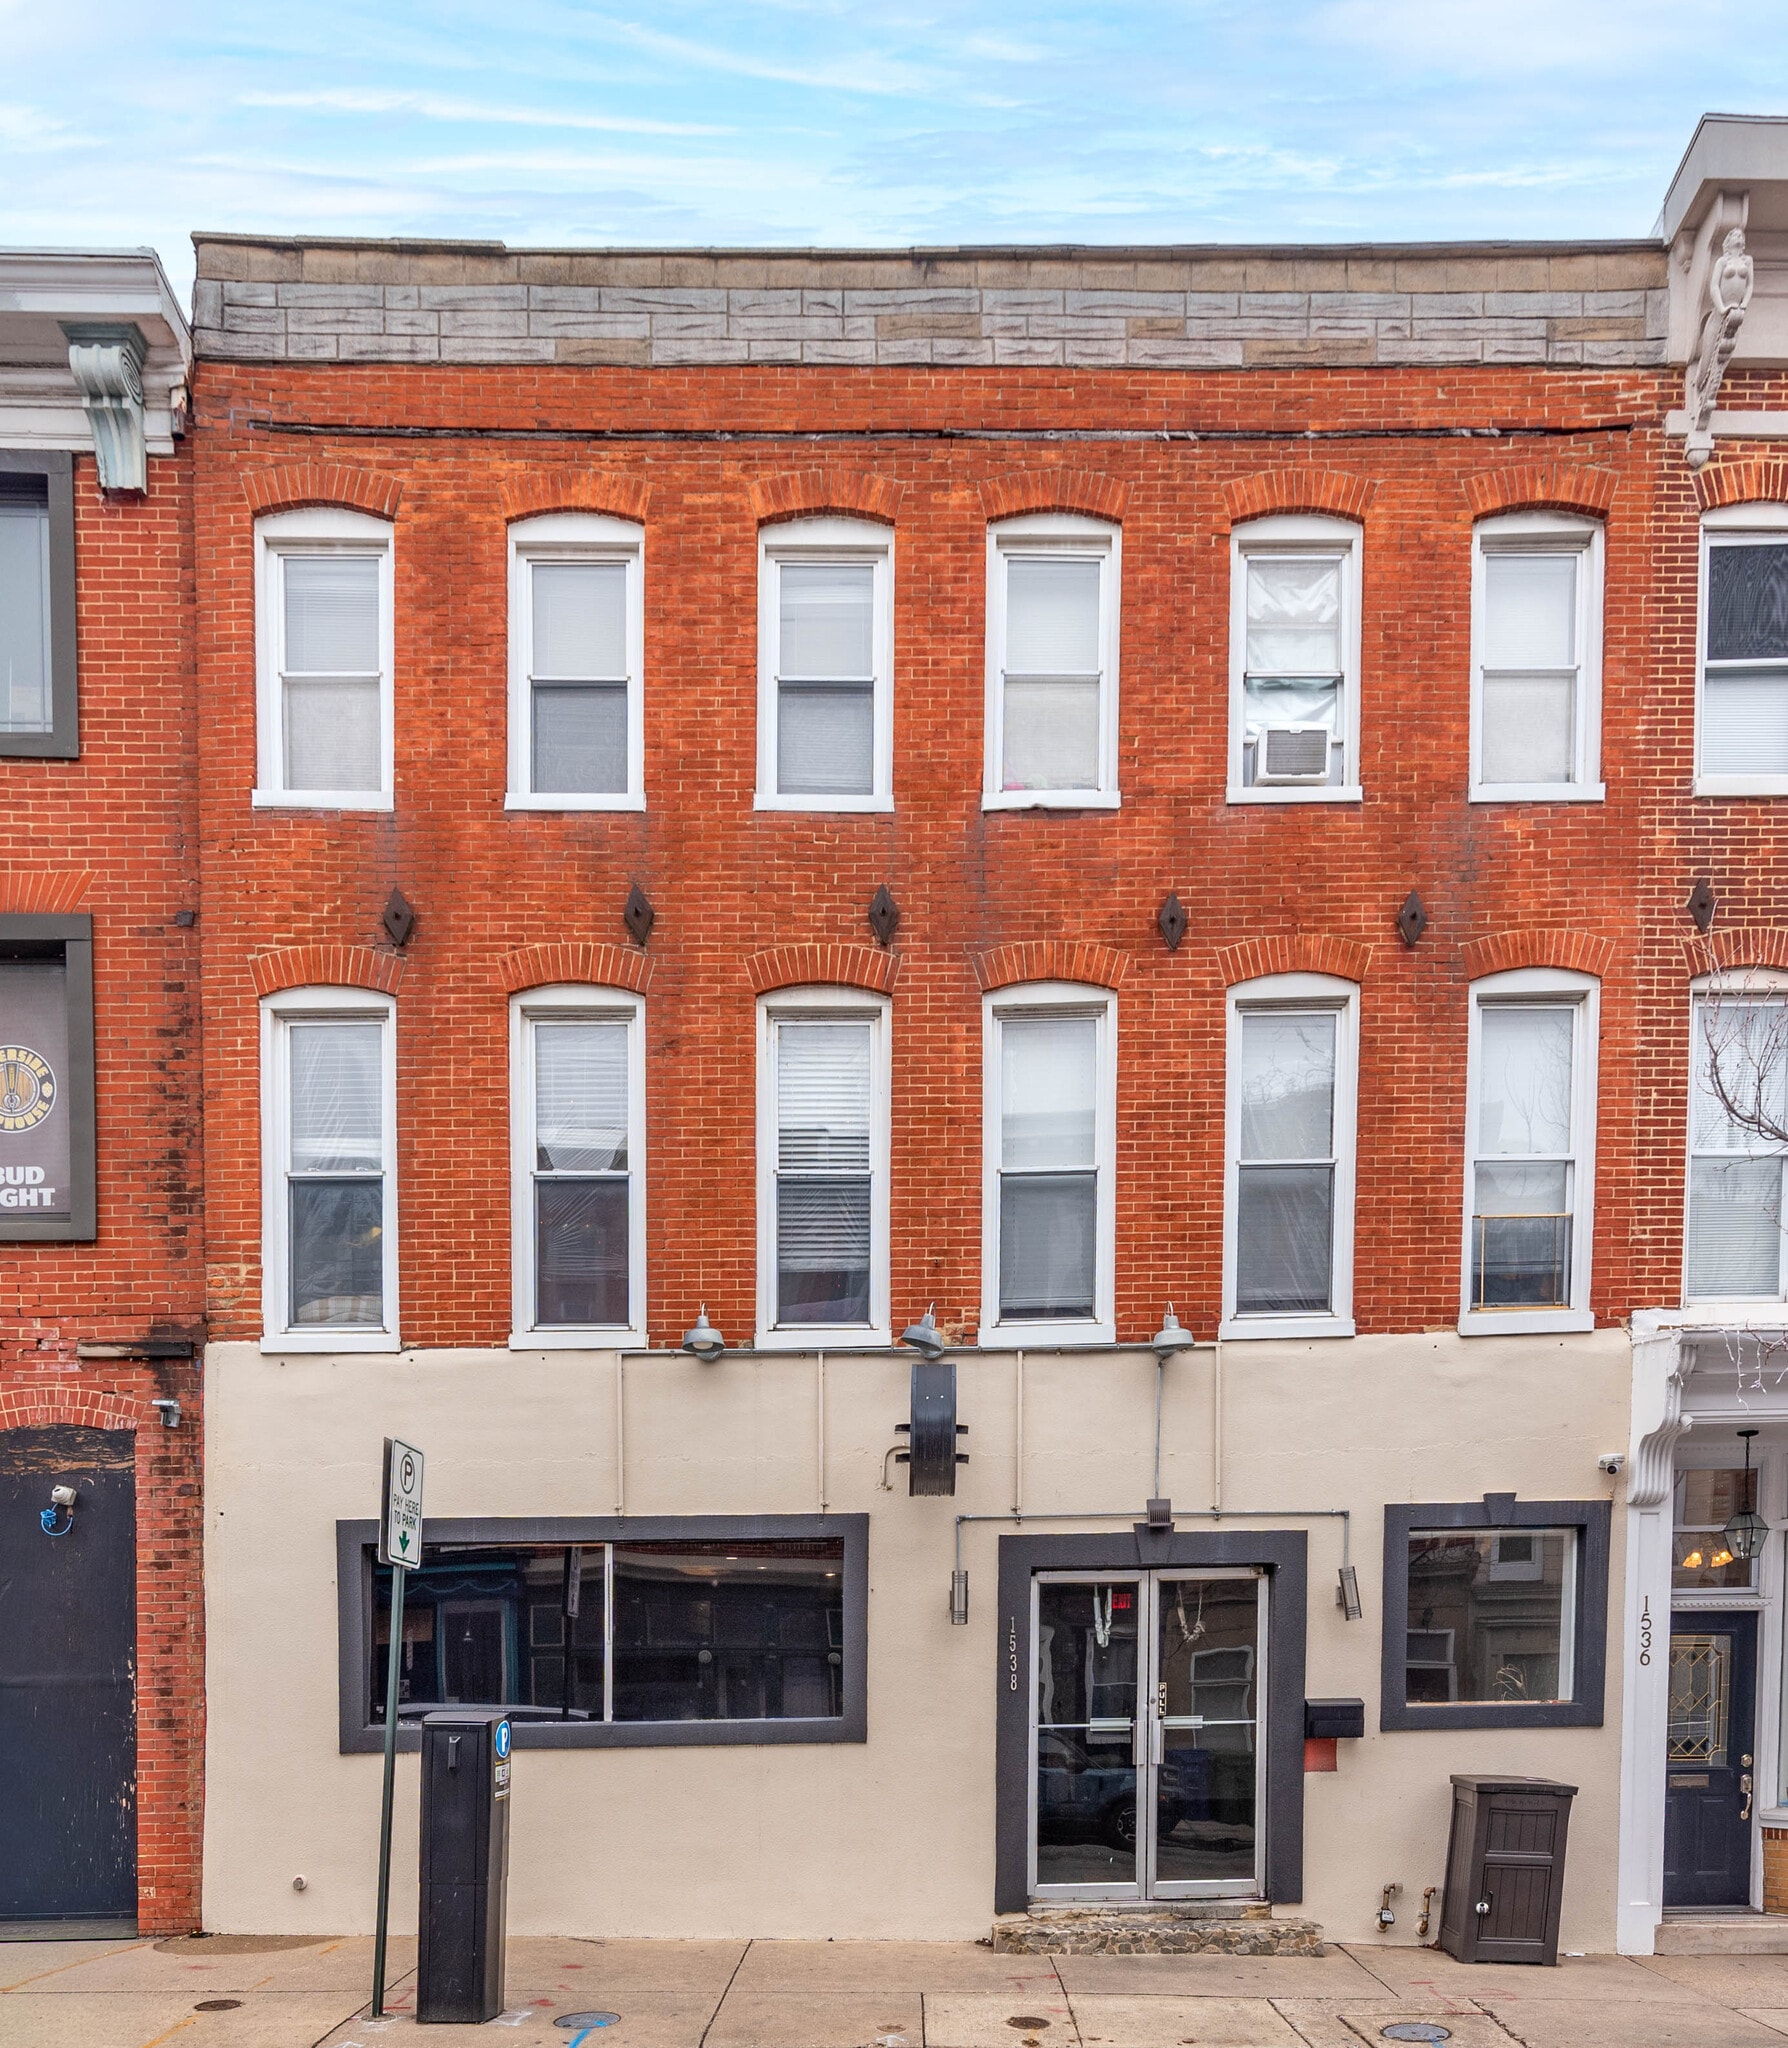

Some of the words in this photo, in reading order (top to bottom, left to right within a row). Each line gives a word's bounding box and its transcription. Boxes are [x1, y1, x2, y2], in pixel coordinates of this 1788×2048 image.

[0, 1166, 45, 1185] UD
[404, 1460, 413, 1487] P
[393, 1493, 404, 1509] PAY
[405, 1497, 419, 1516] HERE
[394, 1509, 401, 1525] TO
[402, 1513, 417, 1531] PARK
[1112, 1593, 1131, 1609] EXIT
[1639, 1595, 1652, 1666] 1536
[1008, 1616, 1018, 1691] 1538
[1158, 1684, 1166, 1715] PULL
[501, 1727, 508, 1753] P
